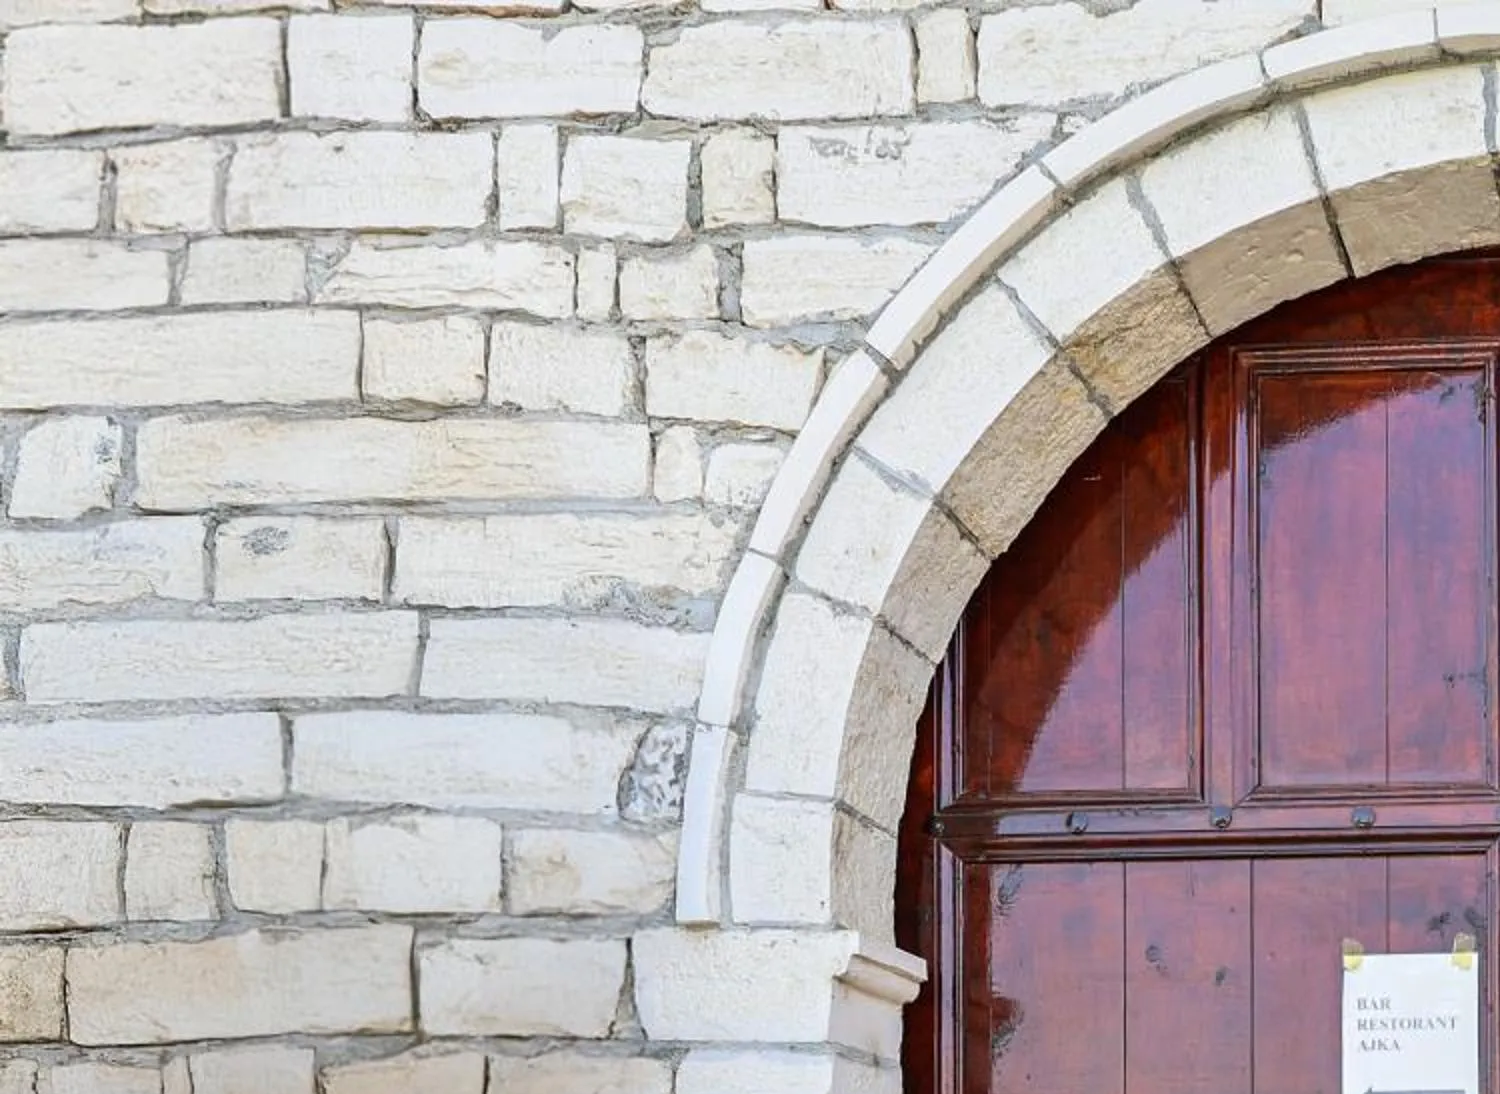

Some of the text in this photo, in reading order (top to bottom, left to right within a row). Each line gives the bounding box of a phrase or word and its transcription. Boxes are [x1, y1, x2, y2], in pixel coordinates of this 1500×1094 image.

[1357, 998, 1391, 1011] BAR
[1357, 1017, 1457, 1032] RESTORANT
[1358, 1039, 1401, 1052] AJKA
